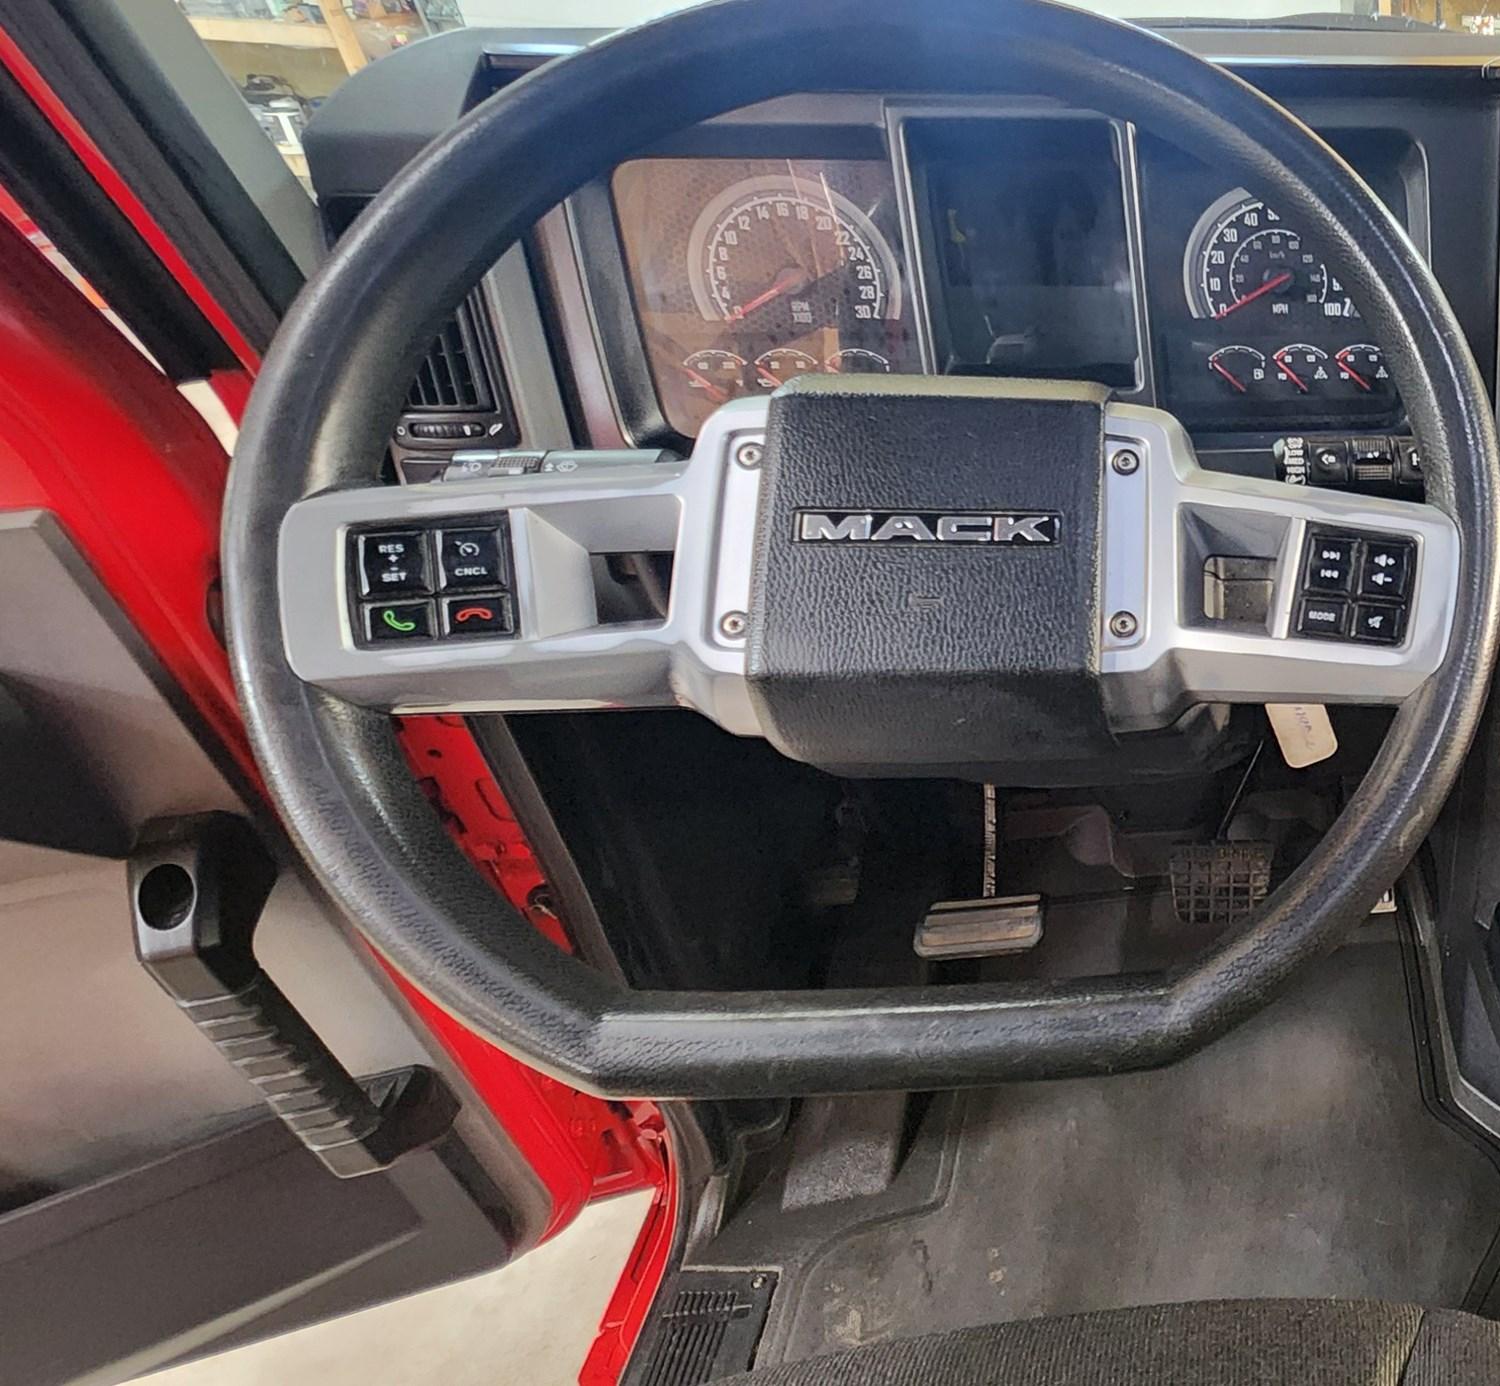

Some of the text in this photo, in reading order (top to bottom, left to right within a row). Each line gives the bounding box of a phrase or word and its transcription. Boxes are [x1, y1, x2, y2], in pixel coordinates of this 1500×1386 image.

[755, 203, 770, 219] 14
[775, 201, 789, 217] 16
[795, 204, 810, 220] 18
[738, 215, 751, 230] 12
[816, 215, 832, 230] 20
[1244, 213, 1258, 226] 40
[724, 230, 738, 245] 10
[835, 230, 851, 245] 22
[1223, 228, 1238, 242] 30
[849, 246, 865, 261] 24
[1211, 251, 1225, 264] 20
[856, 265, 872, 280] 26
[1210, 277, 1221, 291] 10
[859, 285, 875, 300] 28
[855, 305, 871, 319] 30
[1272, 303, 1289, 314] MPH
[1324, 302, 1342, 317] 100
[801, 514, 1051, 542] MACK
[378, 544, 405, 554] RES
[381, 572, 407, 583] SET
[454, 566, 488, 577] CNCL
[1308, 610, 1336, 622] MODE
